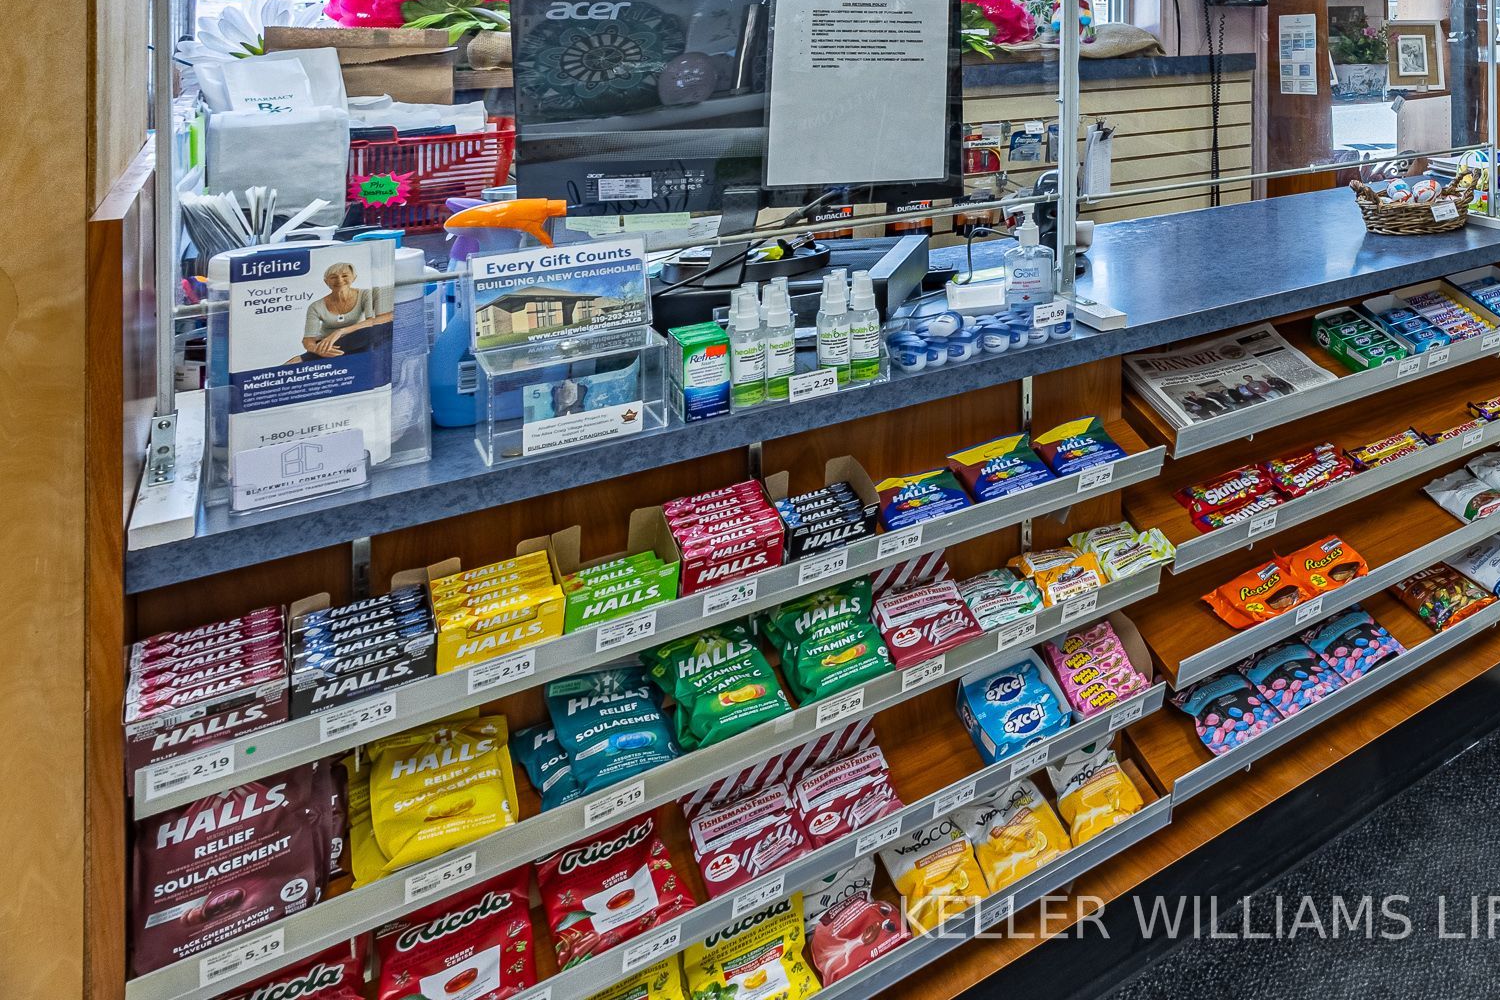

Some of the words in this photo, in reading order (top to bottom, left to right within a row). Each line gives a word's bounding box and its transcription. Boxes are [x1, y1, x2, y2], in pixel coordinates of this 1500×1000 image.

[546, 1, 631, 20] acer
[244, 94, 294, 103] PHARMACY
[897, 202, 931, 213] DURACELL
[815, 211, 852, 222] DURACELL
[242, 261, 300, 277] Lifeline
[487, 259, 534, 274] Every
[540, 254, 570, 267] Gift
[576, 248, 631, 262] Counts
[477, 276, 534, 291] BUILDING
[536, 275, 545, 283] A
[547, 272, 571, 282] NEW
[574, 264, 641, 278] CRAIGHOLME
[248, 286, 288, 296] You're
[244, 294, 282, 307] never
[285, 292, 314, 302] truly
[255, 303, 292, 314] alone
[592, 310, 641, 323] 519-293-3215
[1050, 309, 1064, 319] 0.59
[735, 347, 758, 355] health
[1151, 351, 1223, 371] BANNER
[244, 378, 283, 390] Medical
[286, 374, 310, 383] Alert
[312, 368, 347, 379] Service
[253, 372, 275, 381] with
[277, 369, 293, 377] the
[296, 363, 332, 374] Lifeline
[815, 377, 834, 389] 2.29
[533, 390, 541, 398] 5
[259, 419, 350, 442] 1-800-LIFELINE
[528, 441, 557, 452] BUILDING
[579, 428, 618, 440] CRAIGHOLME
[1095, 472, 1111, 482] 7.29
[1293, 459, 1339, 488] Skittles
[1205, 473, 1259, 505] Skittles
[1223, 496, 1276, 525] Skittles
[900, 536, 919, 546] 1.99
[823, 560, 844, 572] 2.19
[1305, 547, 1343, 570] Reese's
[1240, 573, 1280, 600] Reese's
[731, 589, 753, 602] 2.19
[883, 590, 928, 608] FISHERMAN'S
[896, 601, 920, 610] CHERRY
[1081, 600, 1095, 609] 2.49
[627, 622, 652, 635] 2.19
[896, 629, 914, 638] 44
[1019, 625, 1034, 636] 2.59
[807, 635, 855, 655] VITAMINE
[858, 631, 864, 639] C
[502, 661, 530, 677] 2.19
[694, 662, 741, 687] VITAMIN
[743, 659, 751, 667] C
[753, 669, 762, 677] C
[924, 663, 943, 677] 3.99
[985, 672, 1025, 701] excel
[599, 703, 638, 716] RELIEF
[841, 698, 861, 712] 5.29
[360, 705, 392, 722] 2.19
[1004, 704, 1046, 734] excel
[1126, 708, 1140, 720] 1.49
[151, 752, 177, 763] RELIEF
[1031, 753, 1047, 764] 1.49
[193, 758, 229, 775] 2.19
[425, 766, 470, 786] RELIEF
[802, 762, 850, 791] FISHERMAN'S
[816, 776, 842, 791] CHERRY
[848, 765, 870, 777] CERISE
[616, 790, 641, 806] 5.19
[956, 789, 973, 800] 1.49
[156, 783, 289, 848] HALLS.
[698, 803, 752, 830] FISHERMAN'S
[713, 818, 743, 832] CHERRY
[748, 803, 775, 816] CERISE
[814, 814, 832, 827] 44
[879, 827, 898, 839] 1.49
[195, 828, 255, 859] RELIEF
[559, 819, 653, 874] Ricola
[154, 837, 291, 897] SOULAGEMENT
[443, 862, 472, 880] 5.19
[711, 856, 732, 870] 44
[602, 870, 628, 884] CHERRY
[603, 875, 628, 889] CERISE
[284, 883, 304, 896] 25
[759, 884, 781, 896] 1.49
[397, 892, 511, 951] Ricola
[172, 936, 200, 954] BLACK
[202, 923, 235, 943] CHERRY
[238, 906, 274, 928] FLAVOUR
[179, 941, 212, 958] SAVEUR
[214, 929, 242, 947] CERISE
[245, 915, 270, 936] NOIRE
[722, 943, 737, 954] WITH
[758, 922, 779, 938] ALPINE
[245, 940, 280, 960] 5.19
[652, 935, 676, 951] 2.49
[444, 946, 474, 962] CHERRY
[446, 951, 473, 967] CERISE
[870, 948, 878, 959] 40
